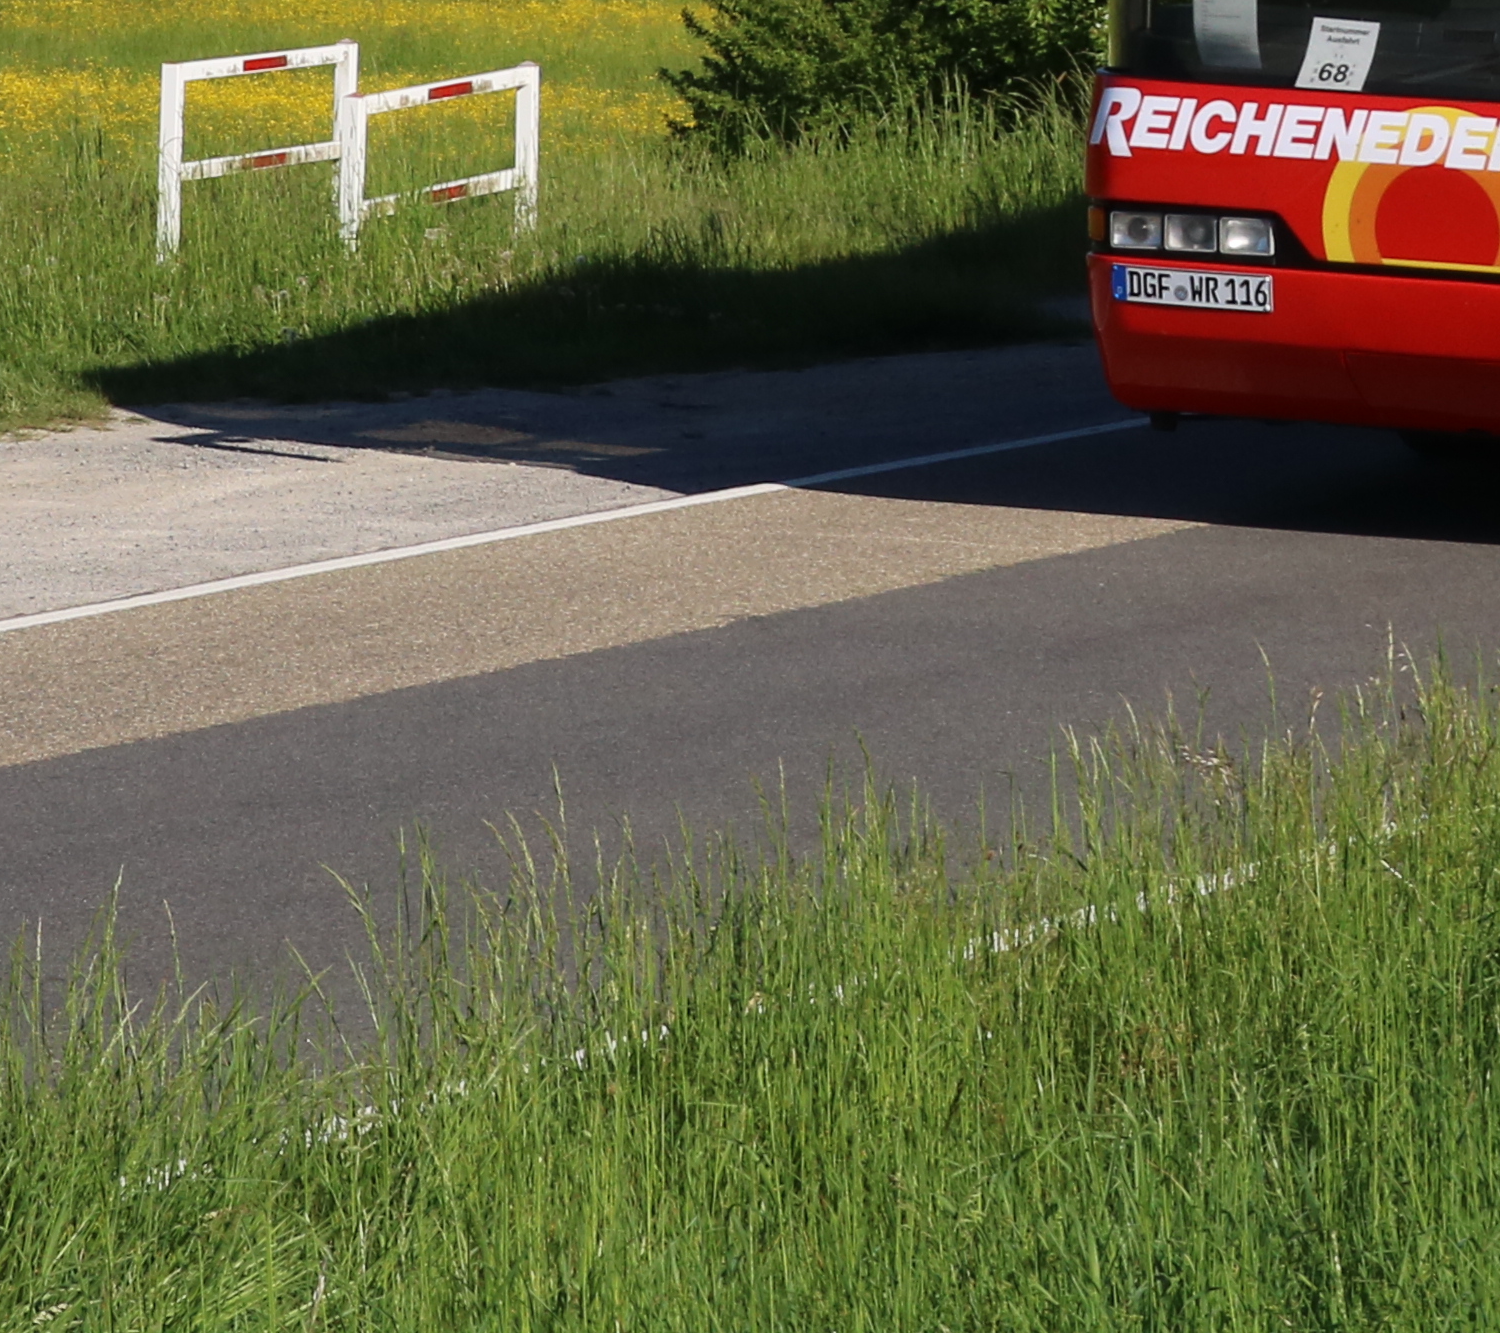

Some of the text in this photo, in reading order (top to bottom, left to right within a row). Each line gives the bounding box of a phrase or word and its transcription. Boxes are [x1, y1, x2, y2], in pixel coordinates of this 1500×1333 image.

[1327, 36, 1360, 45] Ausfahrt
[1318, 63, 1349, 83] 68
[1128, 271, 1268, 307] DGF WR 116
